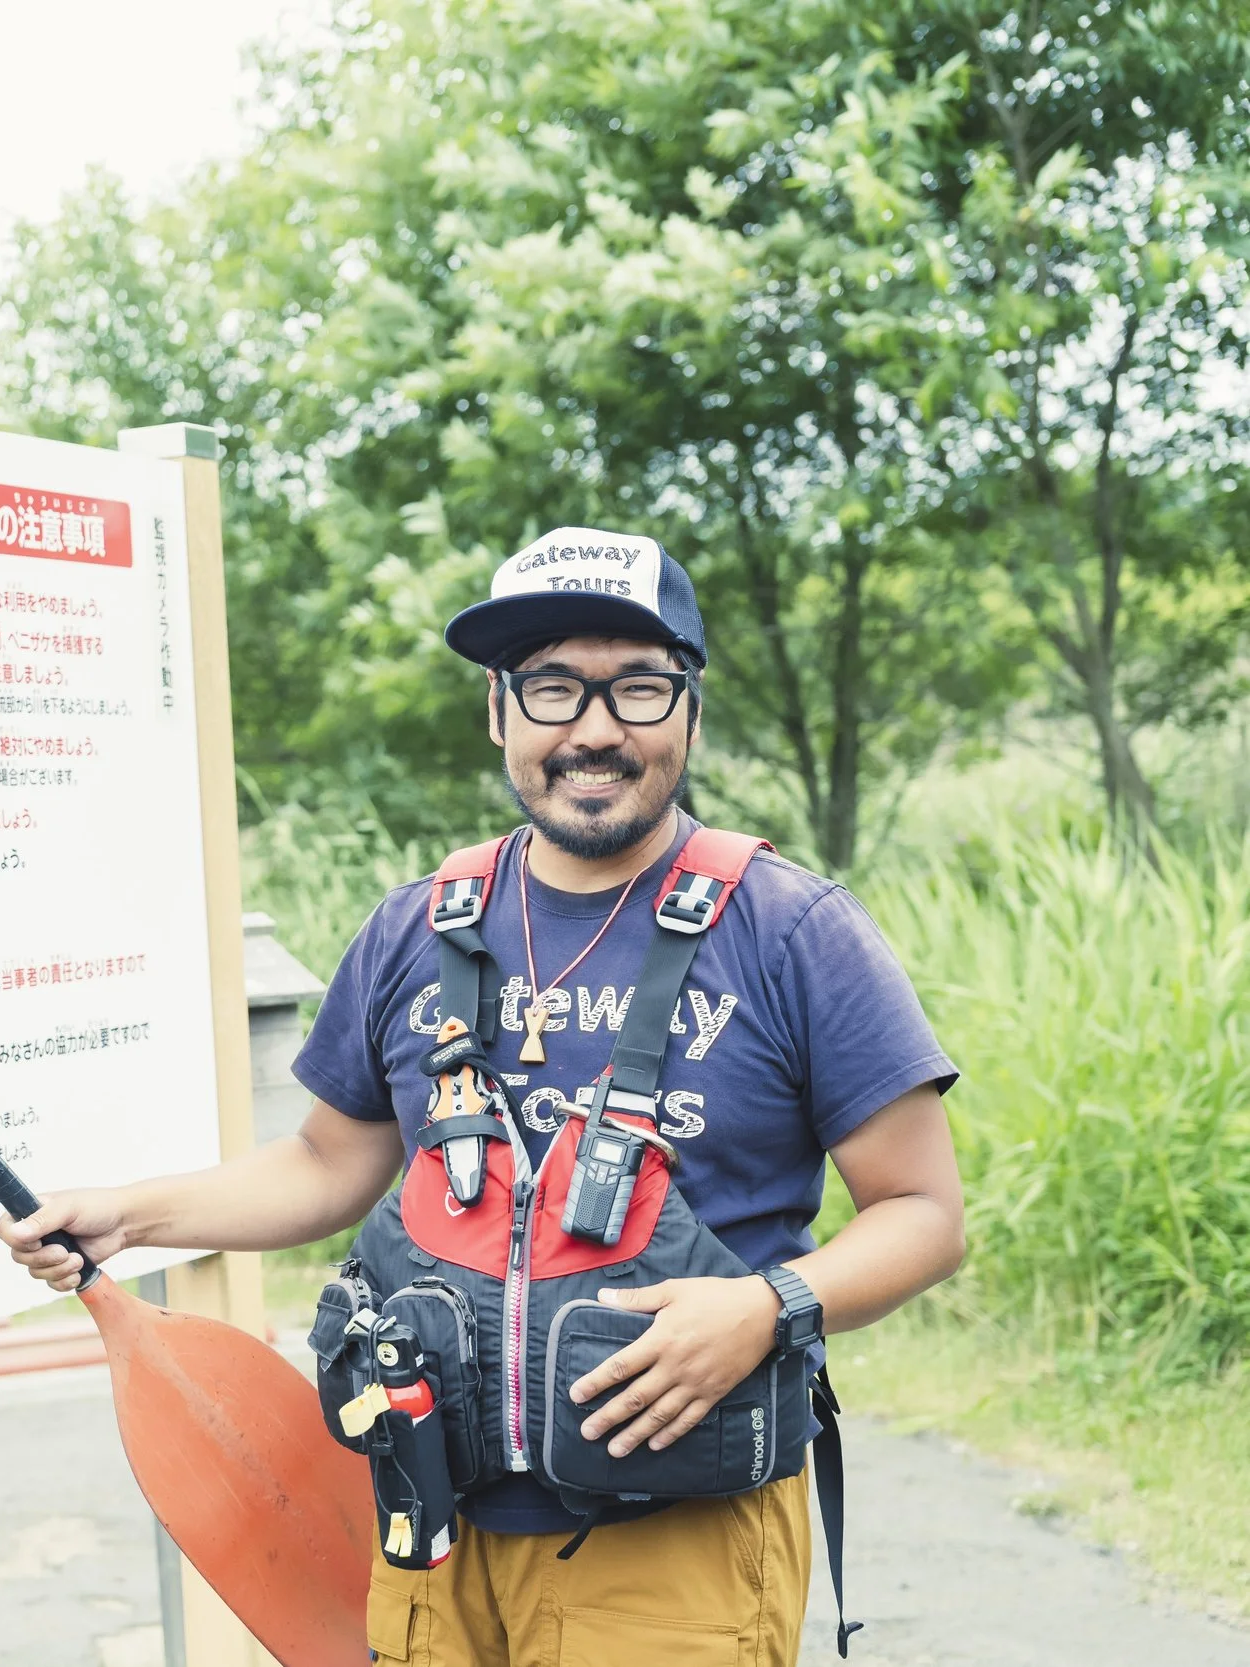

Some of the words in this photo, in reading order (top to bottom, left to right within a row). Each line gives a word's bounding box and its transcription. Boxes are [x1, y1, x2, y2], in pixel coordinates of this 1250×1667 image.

[409, 976, 739, 1061] Gtewy
[751, 1408, 765, 1431] OS
[750, 1431, 765, 1481] chinook
[516, 1544, 641, 1574] Gateway
[546, 1576, 632, 1597] Tours
